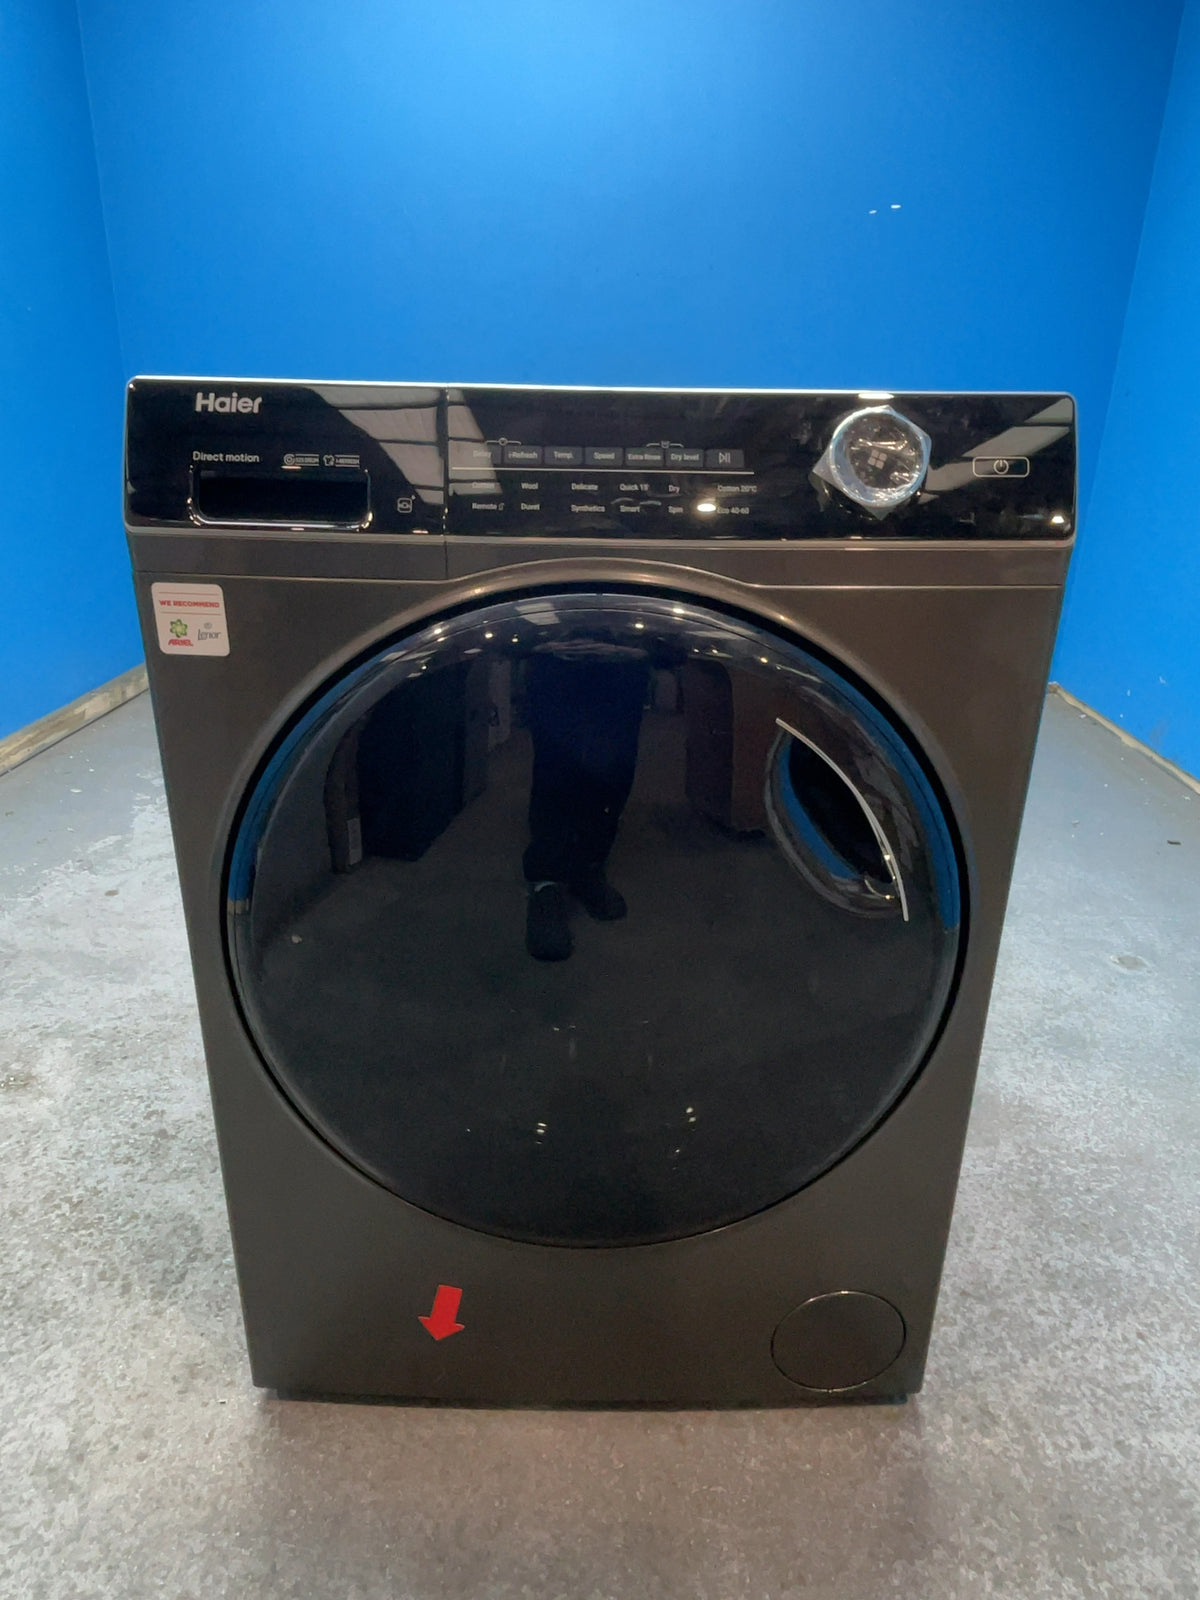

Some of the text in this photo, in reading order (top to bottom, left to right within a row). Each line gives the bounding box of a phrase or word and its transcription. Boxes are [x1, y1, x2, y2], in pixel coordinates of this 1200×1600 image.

[195, 392, 262, 414] Haier
[193, 451, 260, 463] Direct motion
[670, 453, 682, 462] Dry
[668, 485, 680, 494] Dry
[168, 638, 194, 646] ARIEL
